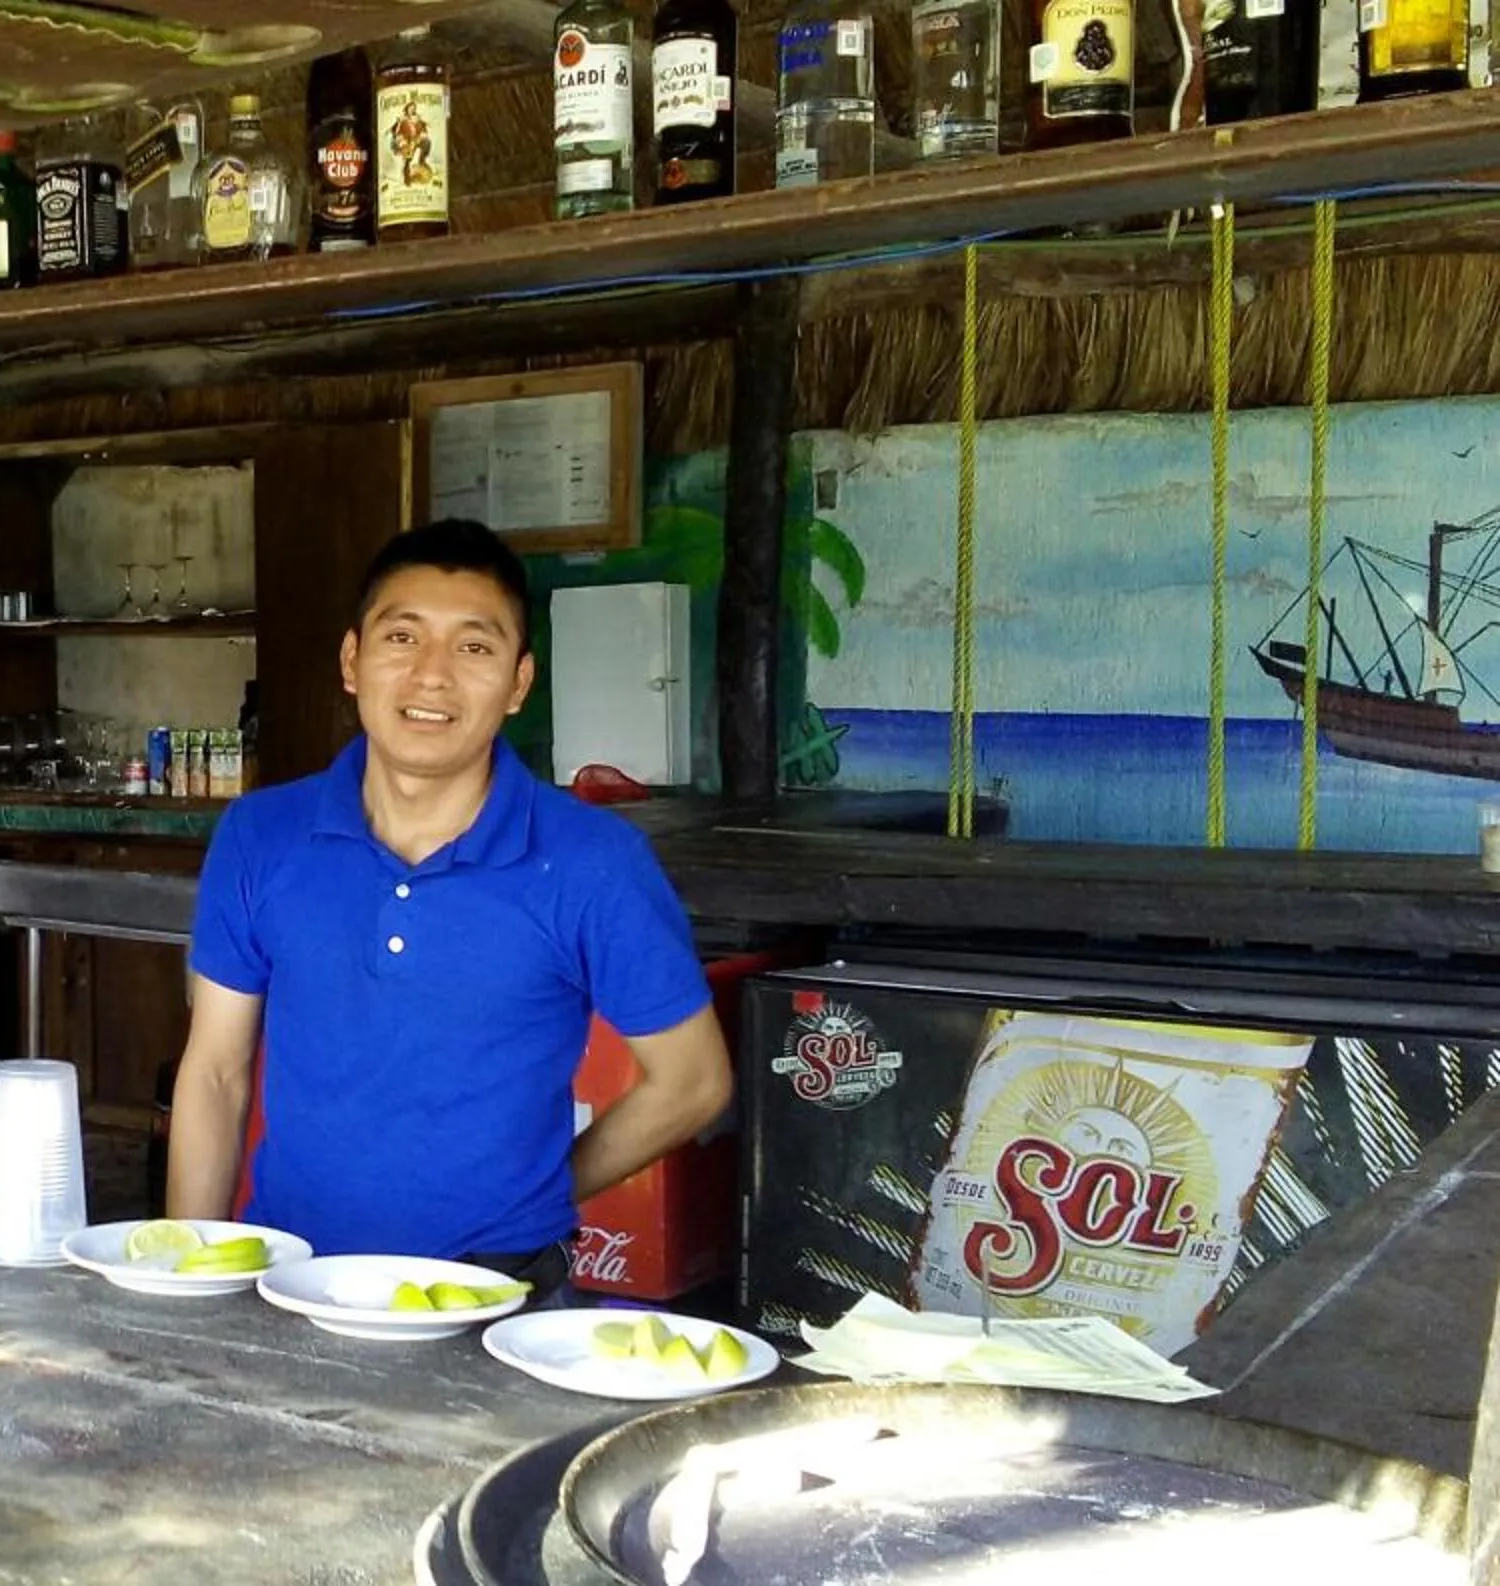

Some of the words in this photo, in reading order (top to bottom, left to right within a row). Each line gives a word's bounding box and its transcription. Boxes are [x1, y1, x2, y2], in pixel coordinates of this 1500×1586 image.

[318, 148, 368, 164] Havana
[327, 162, 358, 177] Club
[945, 1175, 987, 1200] DESDE
[1189, 1241, 1223, 1262] 1899
